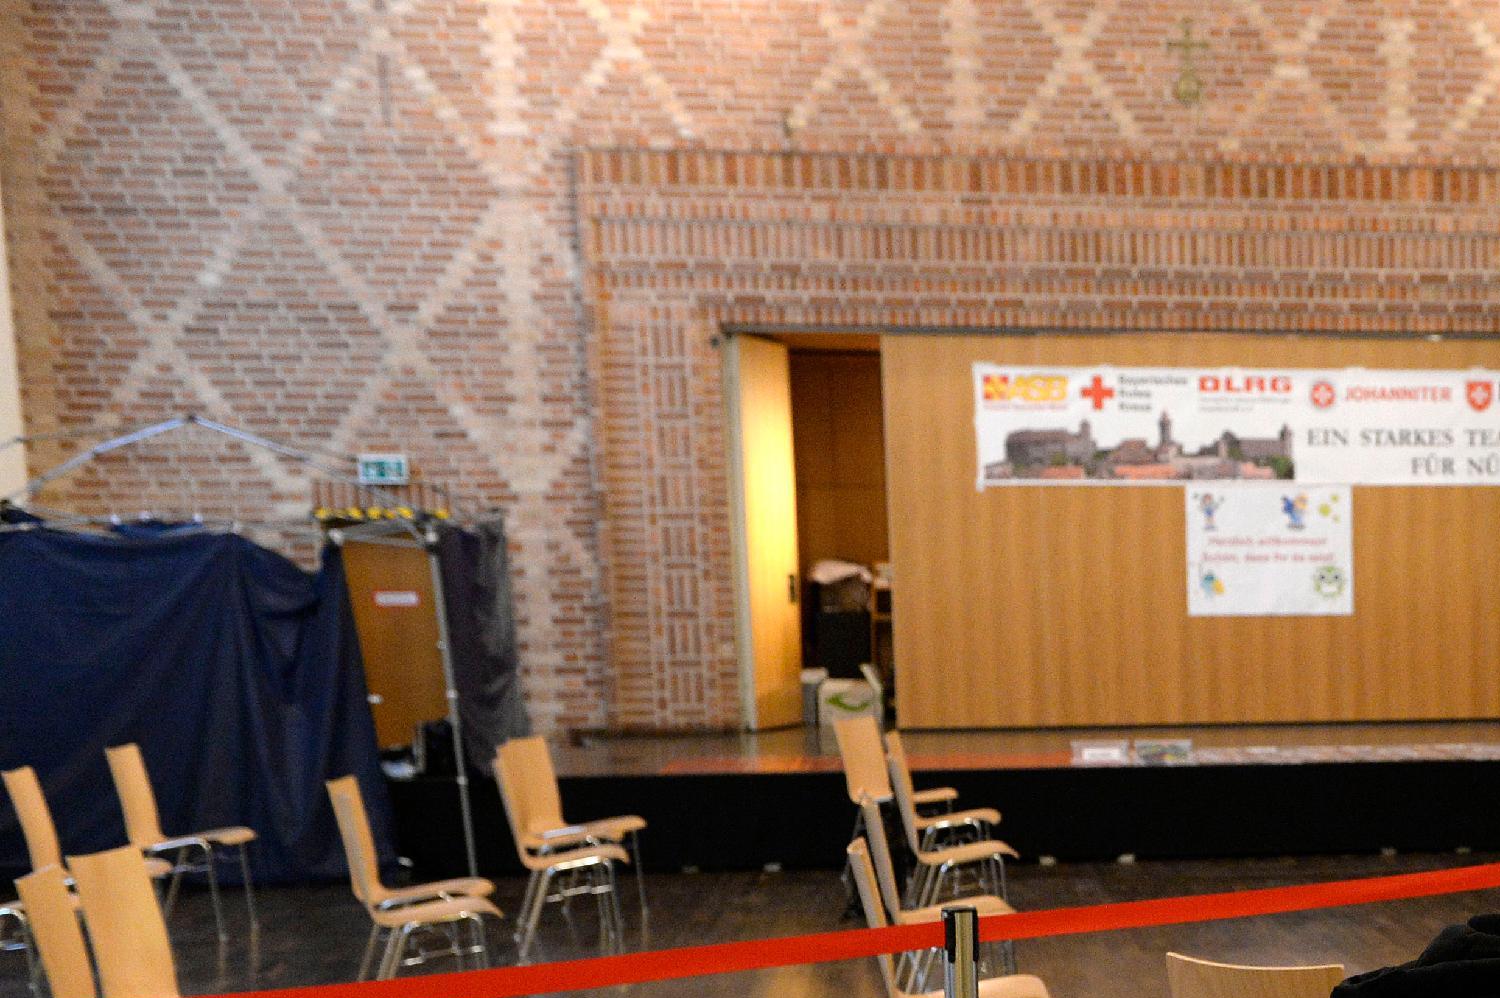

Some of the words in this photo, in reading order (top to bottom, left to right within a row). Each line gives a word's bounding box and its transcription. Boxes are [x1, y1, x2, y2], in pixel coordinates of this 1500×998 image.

[1008, 375, 1069, 400] ASB
[1199, 375, 1292, 393] DLRG
[1345, 386, 1453, 402] JOHANNITER
[1307, 428, 1349, 448] EIN
[1360, 428, 1454, 448] STARKES
[1411, 453, 1455, 476] FÜR
